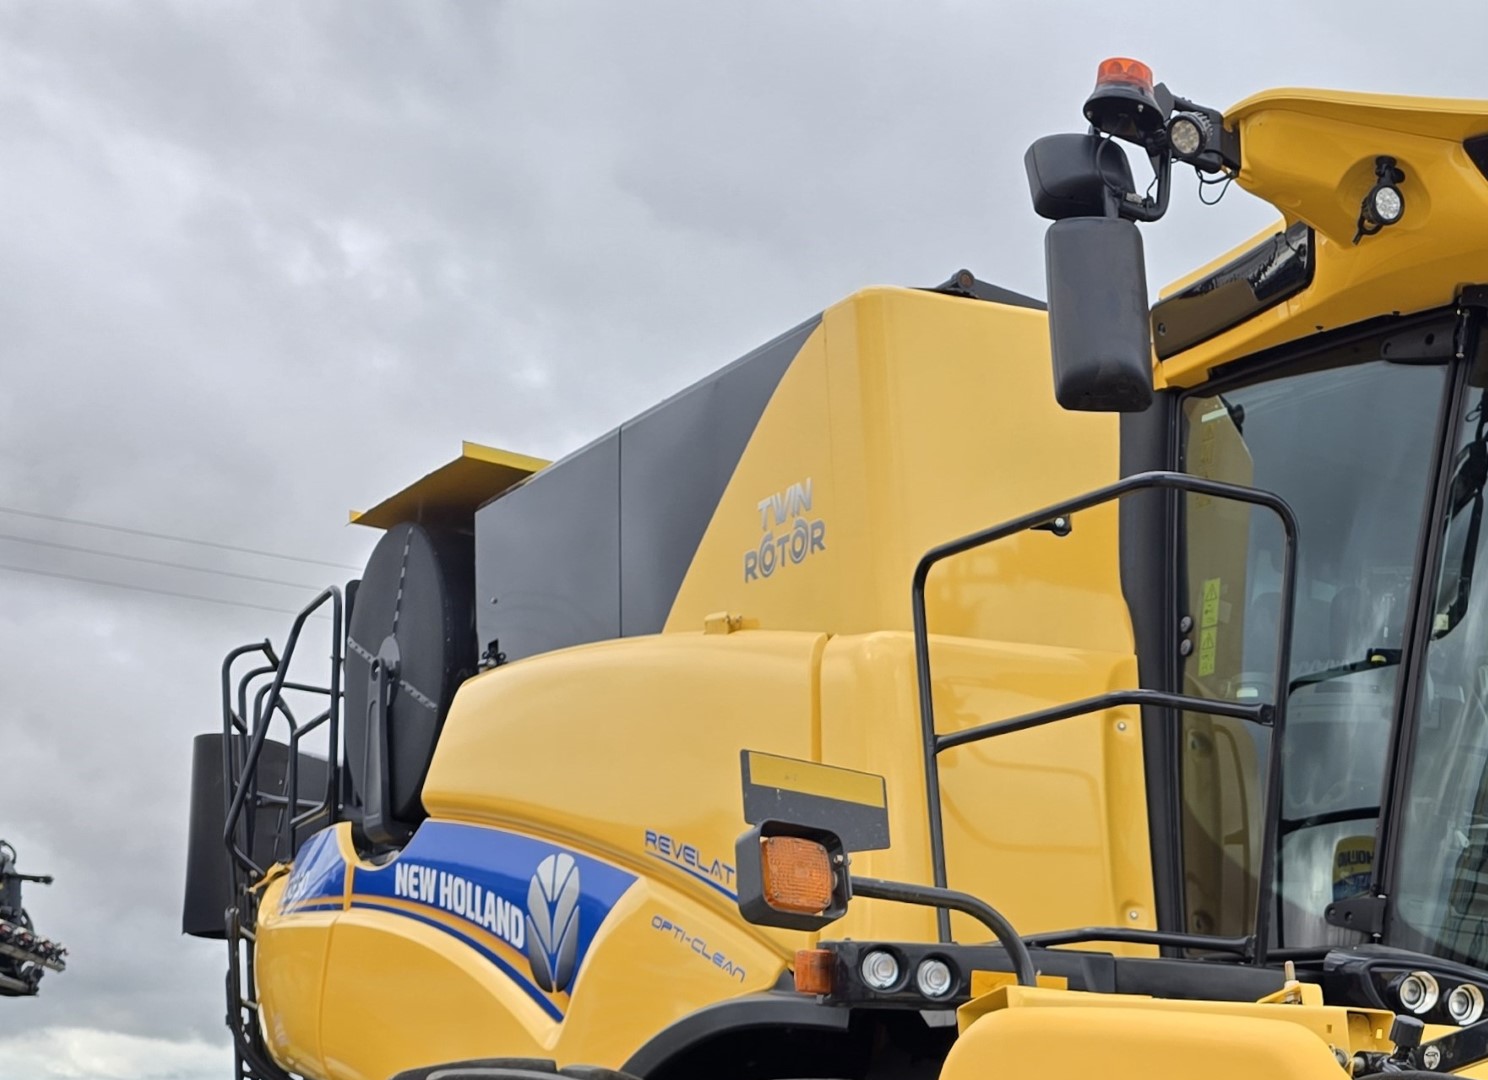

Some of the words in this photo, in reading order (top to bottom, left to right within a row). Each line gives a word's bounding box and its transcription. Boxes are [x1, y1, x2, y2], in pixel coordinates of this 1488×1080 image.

[757, 477, 813, 531] TWIN
[743, 518, 826, 583] ROTOR
[645, 830, 736, 885] REVELAT
[395, 862, 437, 904] NEW
[439, 871, 525, 949] HOLLAND
[651, 915, 747, 983] OPTI-CLEAN
